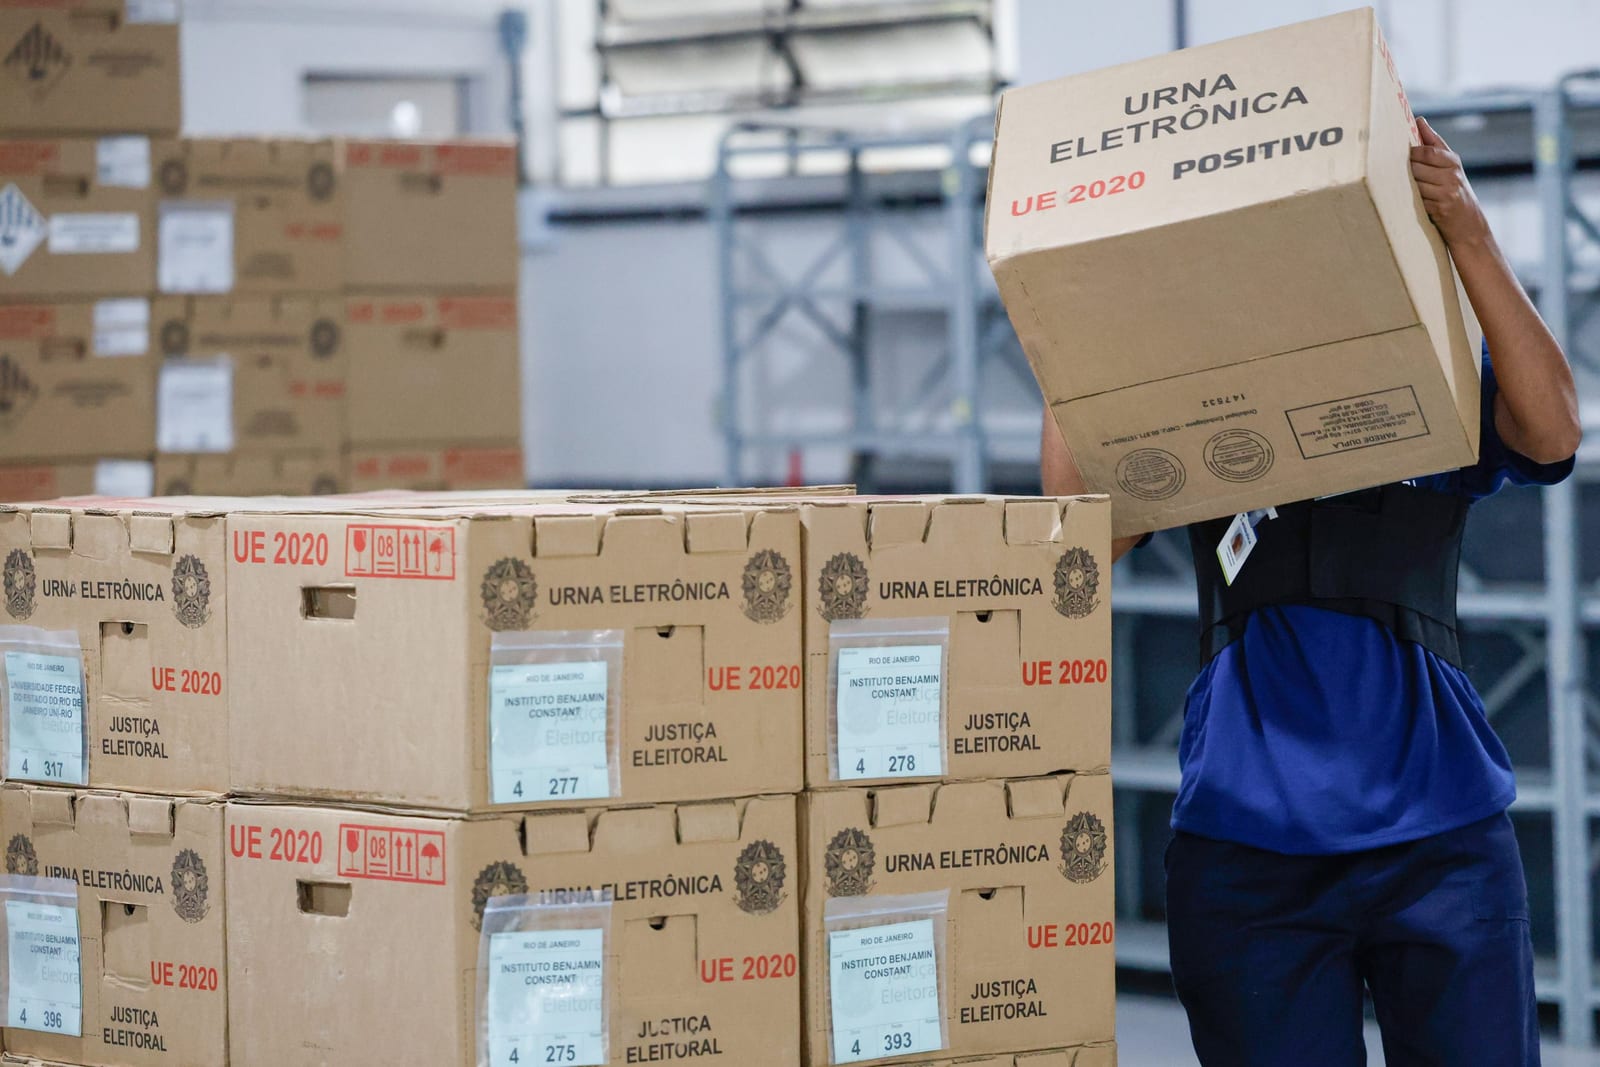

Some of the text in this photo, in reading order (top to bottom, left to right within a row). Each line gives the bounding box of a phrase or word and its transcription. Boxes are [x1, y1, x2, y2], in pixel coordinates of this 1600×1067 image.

[1124, 73, 1236, 116] URNA
[1050, 86, 1308, 164] ELETRÔNICA
[1172, 126, 1344, 181] POSITIVO
[1010, 170, 1146, 217] UE 2020
[1333, 438, 1362, 449] DUPLA
[1364, 431, 1397, 445] PAREDE
[233, 530, 328, 566] UE 2020
[376, 534, 394, 556] 08
[43, 579, 164, 602] URNA ELETRÔNICA
[549, 579, 730, 606] URNA ELETRÔNICA
[880, 575, 1043, 599] URNA ELETRÔNICA
[882, 656, 891, 664] DE
[152, 666, 222, 696] UE 2020
[708, 665, 800, 690] UE 2020
[850, 675, 939, 688] INSTITUTO BENJAMIN
[1022, 659, 1107, 686] UE 2020
[49, 696, 58, 704] DO
[60, 697, 71, 706] RIO
[72, 698, 82, 707] DE
[504, 693, 604, 706] INSTITUTO BENJAMIN
[872, 688, 916, 698] CONSTANT
[529, 707, 581, 718] CONSTANT
[964, 712, 1030, 732] JUSTIÇA
[109, 716, 160, 738] JUSTIÇA
[644, 722, 716, 744] JUSTIÇA
[102, 738, 168, 759] ELEITORAL
[954, 734, 1040, 754] ELEITORAL
[632, 746, 727, 766] ELEITORAL
[856, 755, 916, 774] 4 278
[22, 758, 63, 778] 4 317
[513, 777, 578, 797] 4 277
[230, 824, 322, 864] UE 2020
[370, 836, 386, 859] 08
[886, 842, 1049, 872] URNA ELETRÔNICA
[82, 869, 164, 894] ELETRÔNICA
[601, 874, 722, 901] ELETRÔNICA
[45, 934, 76, 945] BENJAMIN
[549, 940, 580, 948] JANEIRO
[860, 932, 913, 946] RIO DE JANEIRO
[1028, 921, 1112, 948] UE 2020
[30, 945, 62, 956] CONSTANT
[842, 950, 932, 970] INSTITUTO BENJAMIN
[151, 960, 218, 992] UE 2020
[502, 960, 600, 973] INSTITUTO BENJAMIN
[701, 954, 796, 983] UE 2020
[864, 965, 911, 980] CONSTANT
[525, 974, 576, 985] CONSTANT
[971, 978, 1037, 1000] JUSTIÇA
[20, 1008, 62, 1028] 4 396
[110, 1006, 158, 1029] JUSTIÇA
[960, 1000, 1046, 1024] ELEITORAL
[103, 1028, 168, 1052] ELEITORAL
[626, 1038, 722, 1064] ELEITORAL
[852, 1032, 912, 1055] 4 393
[509, 1045, 576, 1064] 4 275
